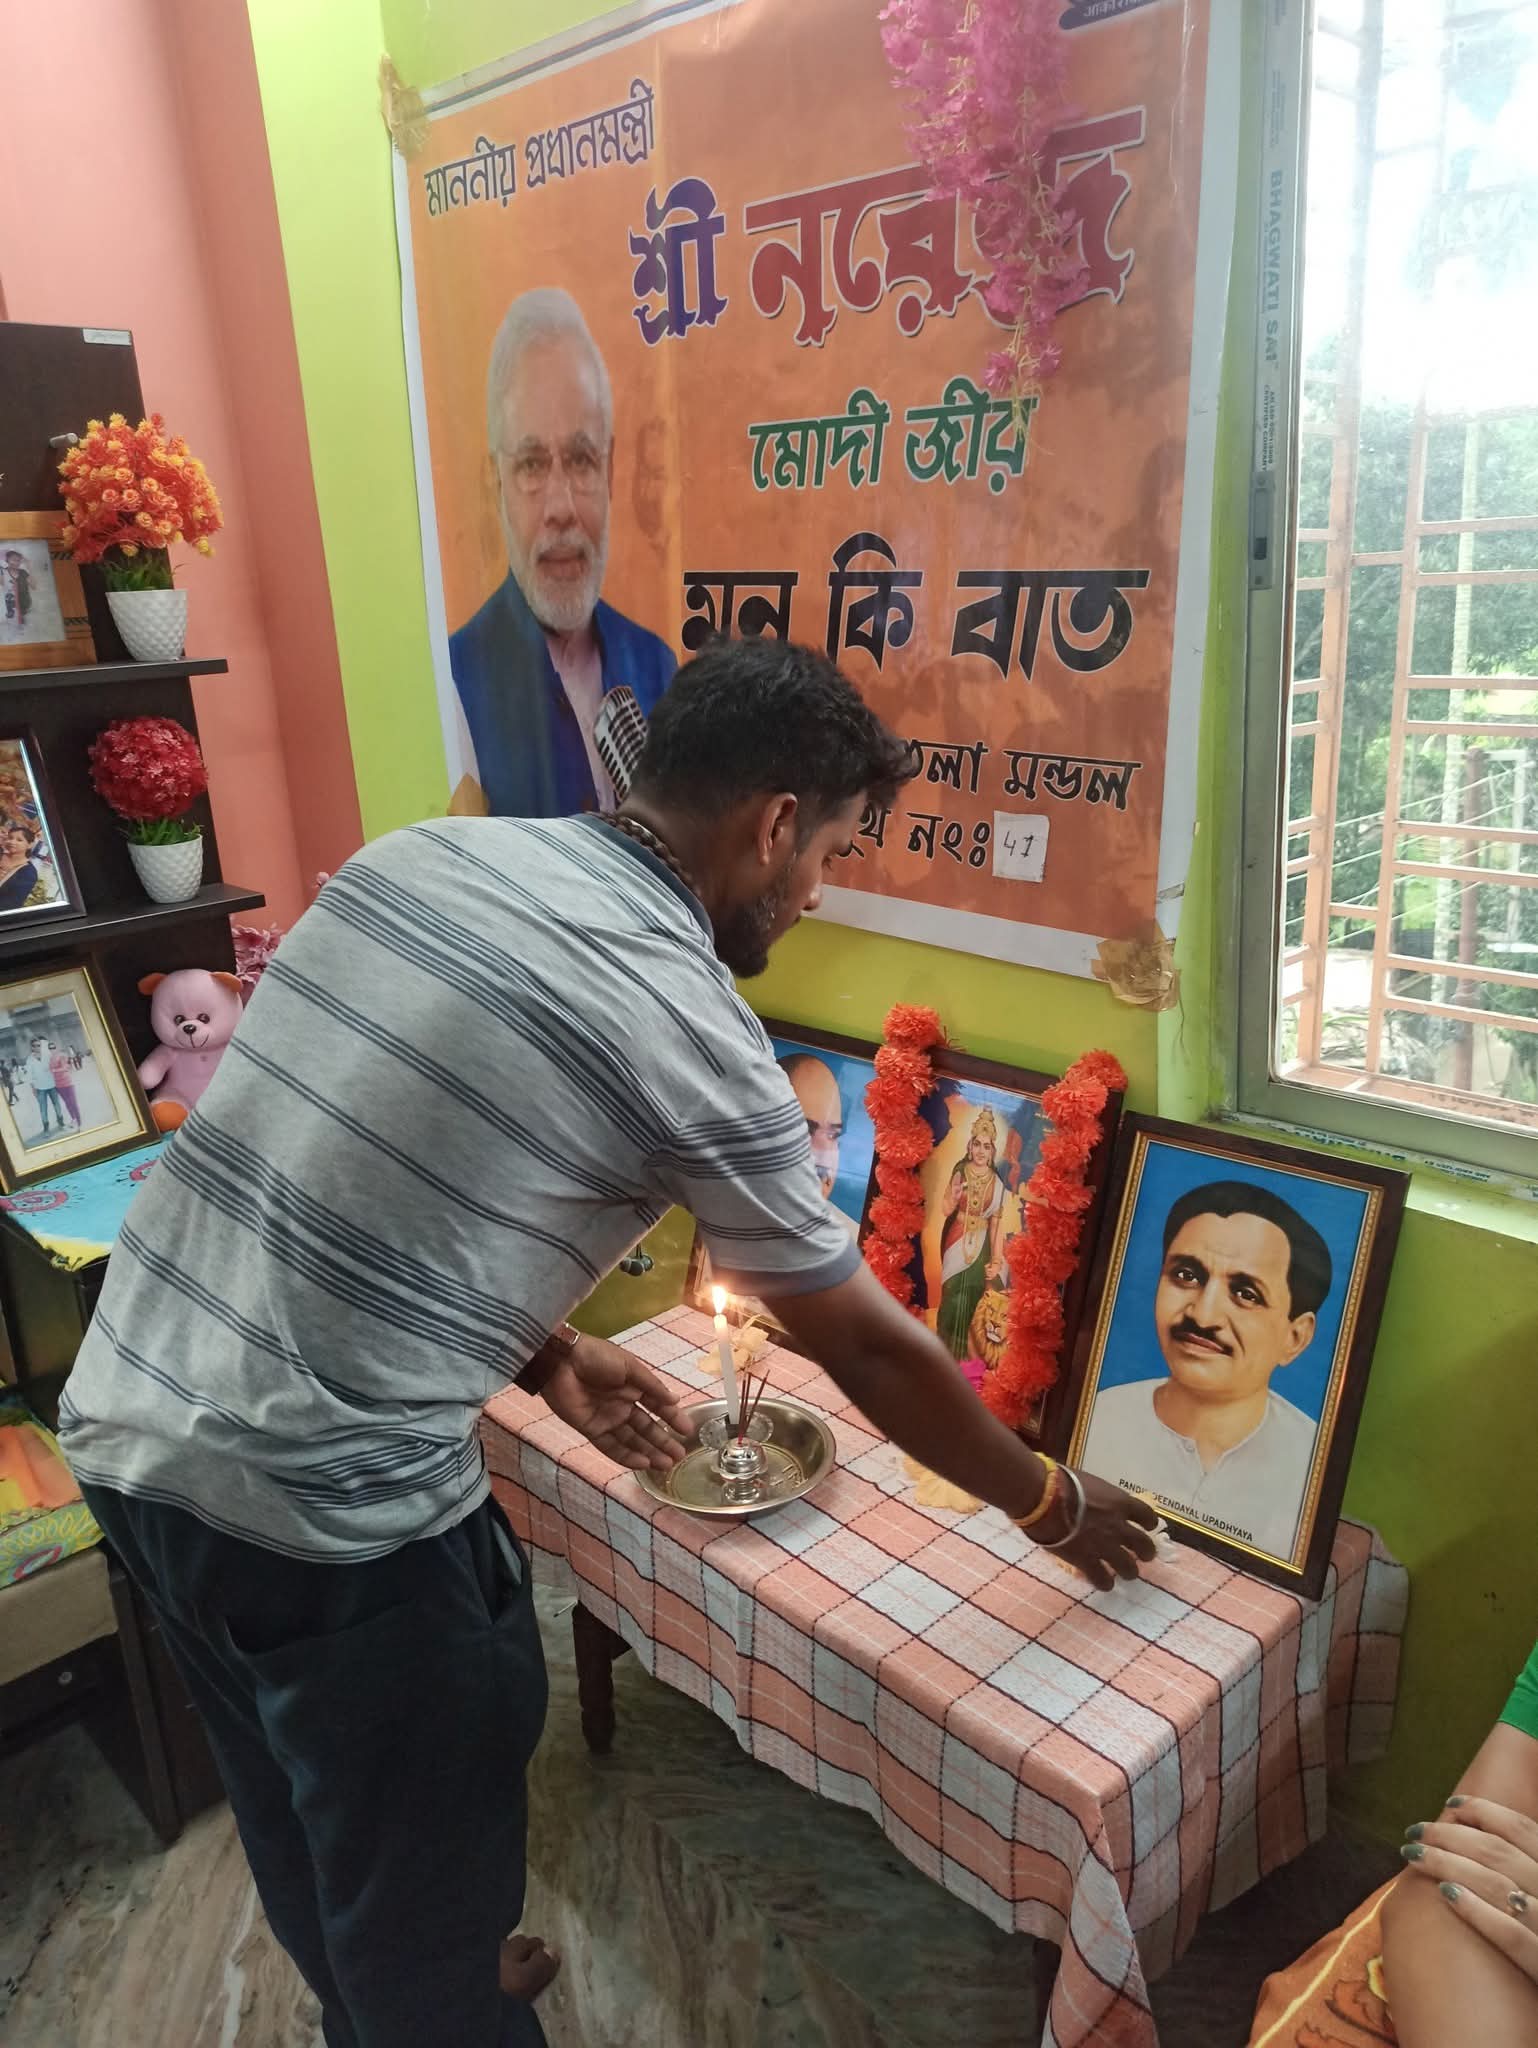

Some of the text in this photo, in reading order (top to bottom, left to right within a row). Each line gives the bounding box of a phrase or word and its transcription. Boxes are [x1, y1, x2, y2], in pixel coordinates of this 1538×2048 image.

[424, 78, 655, 216] মাননীয় প্রধানমন্ত্রী
[628, 177, 728, 346] শ্রী
[1267, 169, 1283, 310] BHAGWATI
[749, 374, 1038, 495] মোদী জীর
[681, 531, 1151, 682] মন কি বাত
[1003, 830, 1034, 858] 41
[1119, 1478, 1148, 1495] PAND
[1201, 1513, 1254, 1542] UPADHYAYA
